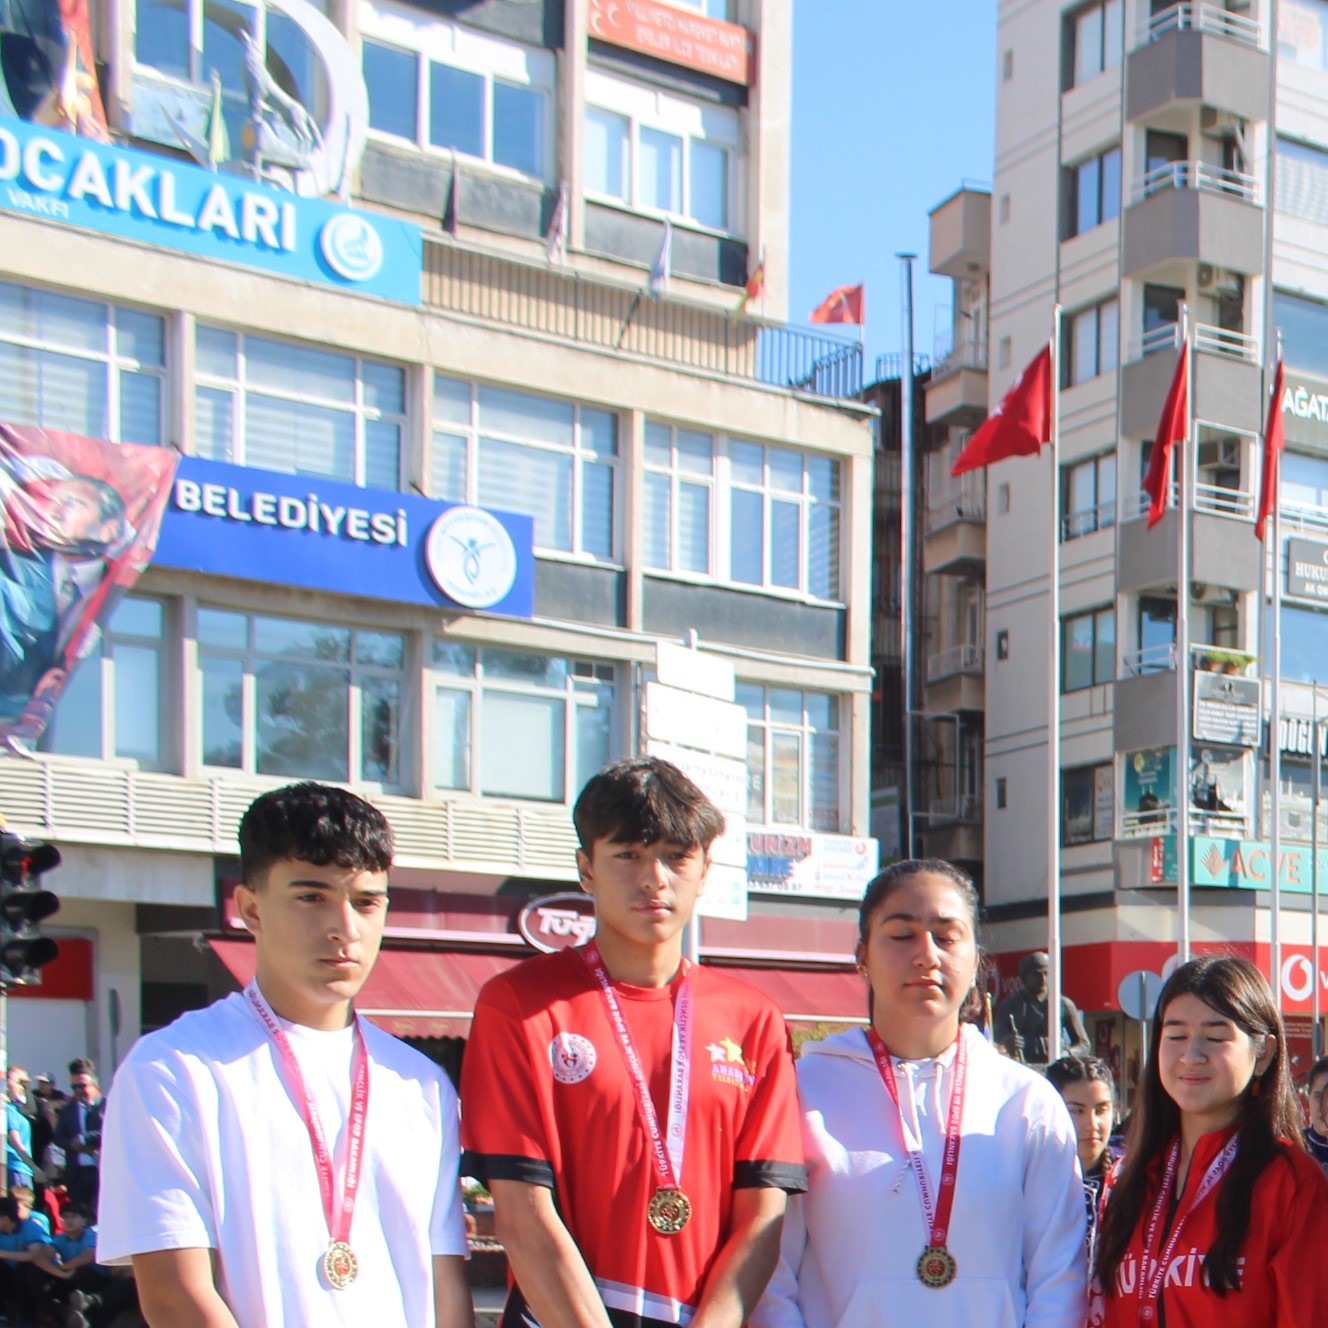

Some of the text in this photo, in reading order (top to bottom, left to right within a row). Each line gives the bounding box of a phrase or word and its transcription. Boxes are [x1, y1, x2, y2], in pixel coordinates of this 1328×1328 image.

[175, 479, 408, 547] BELEDİYESİ
[749, 833, 813, 856] URİZM
[613, 1010, 626, 1035] SPOR
[655, 1141, 669, 1177] TÜRKİYE
[1148, 1267, 1165, 1299] TÜRKİYE
